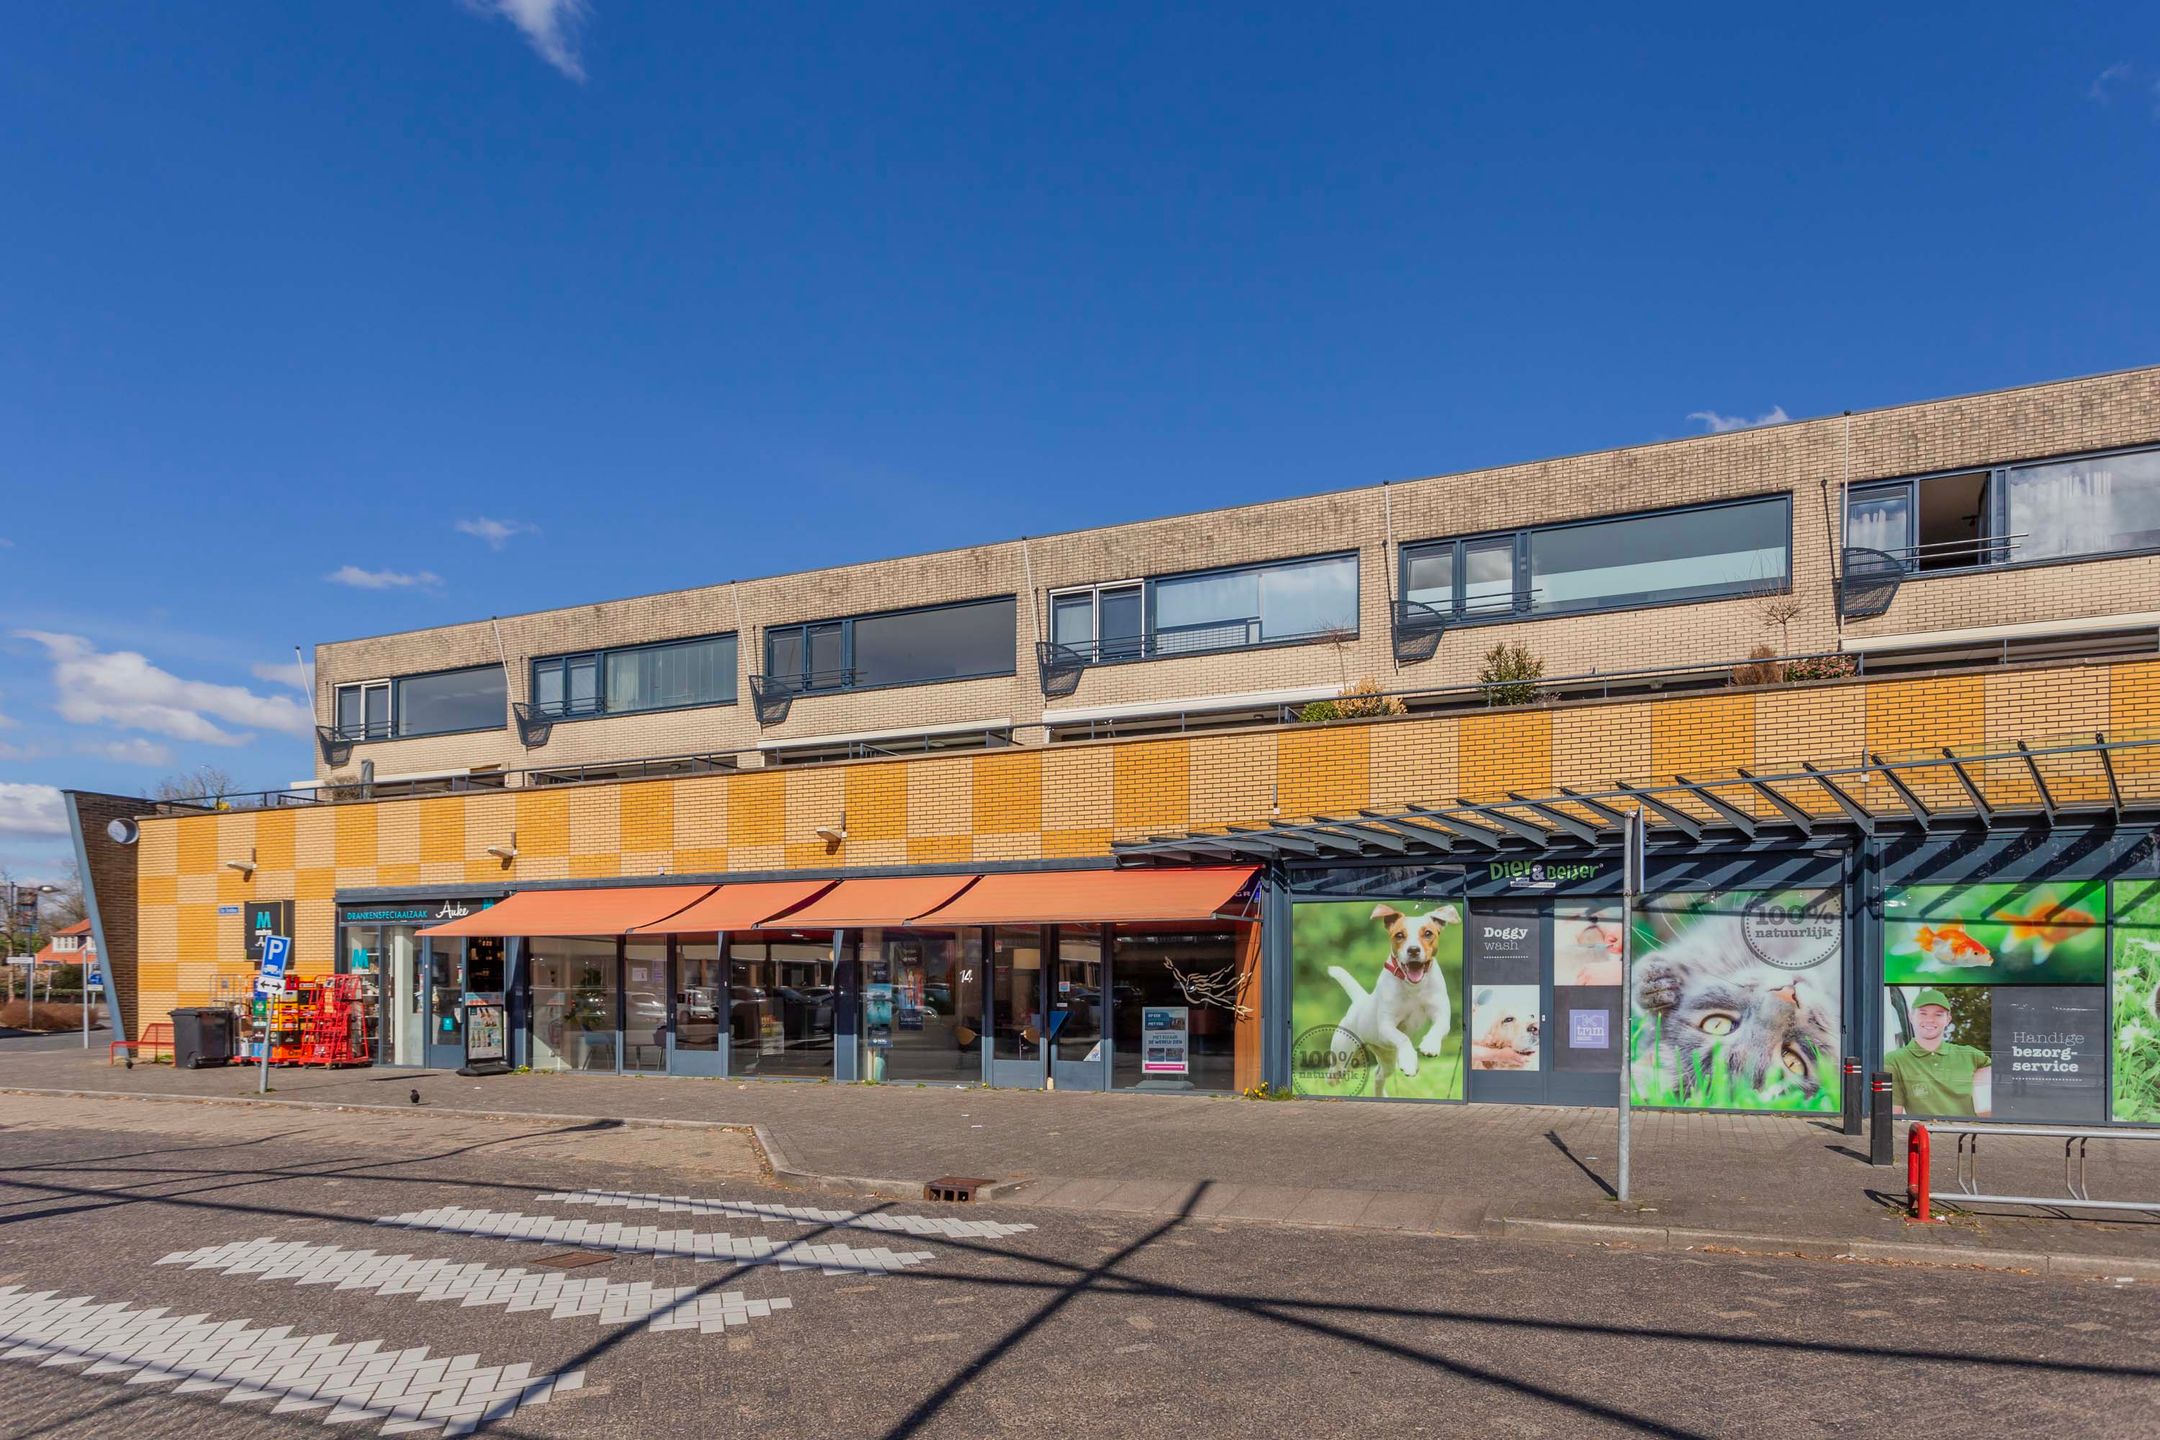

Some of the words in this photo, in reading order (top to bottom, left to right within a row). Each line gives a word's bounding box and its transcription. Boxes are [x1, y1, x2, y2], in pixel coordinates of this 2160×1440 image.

[1490, 861, 1535, 880] Dier
[1532, 864, 1545, 880] &
[347, 910, 428, 920] DRANKENSPECIAALZAAK
[435, 900, 469, 919] Auke
[1756, 904, 1835, 925] 100%
[1484, 927, 1529, 940] Doggy
[1755, 926, 1833, 940] natuurlijk
[268, 939, 283, 960] P
[1484, 940, 1519, 951] wash
[2013, 1031, 2085, 1046] Handige
[1300, 1050, 1360, 1068] 100%
[2012, 1046, 2078, 1060] bezorg-
[2012, 1060, 2079, 1072] service
[1299, 1070, 1361, 1082] natuurlijk
